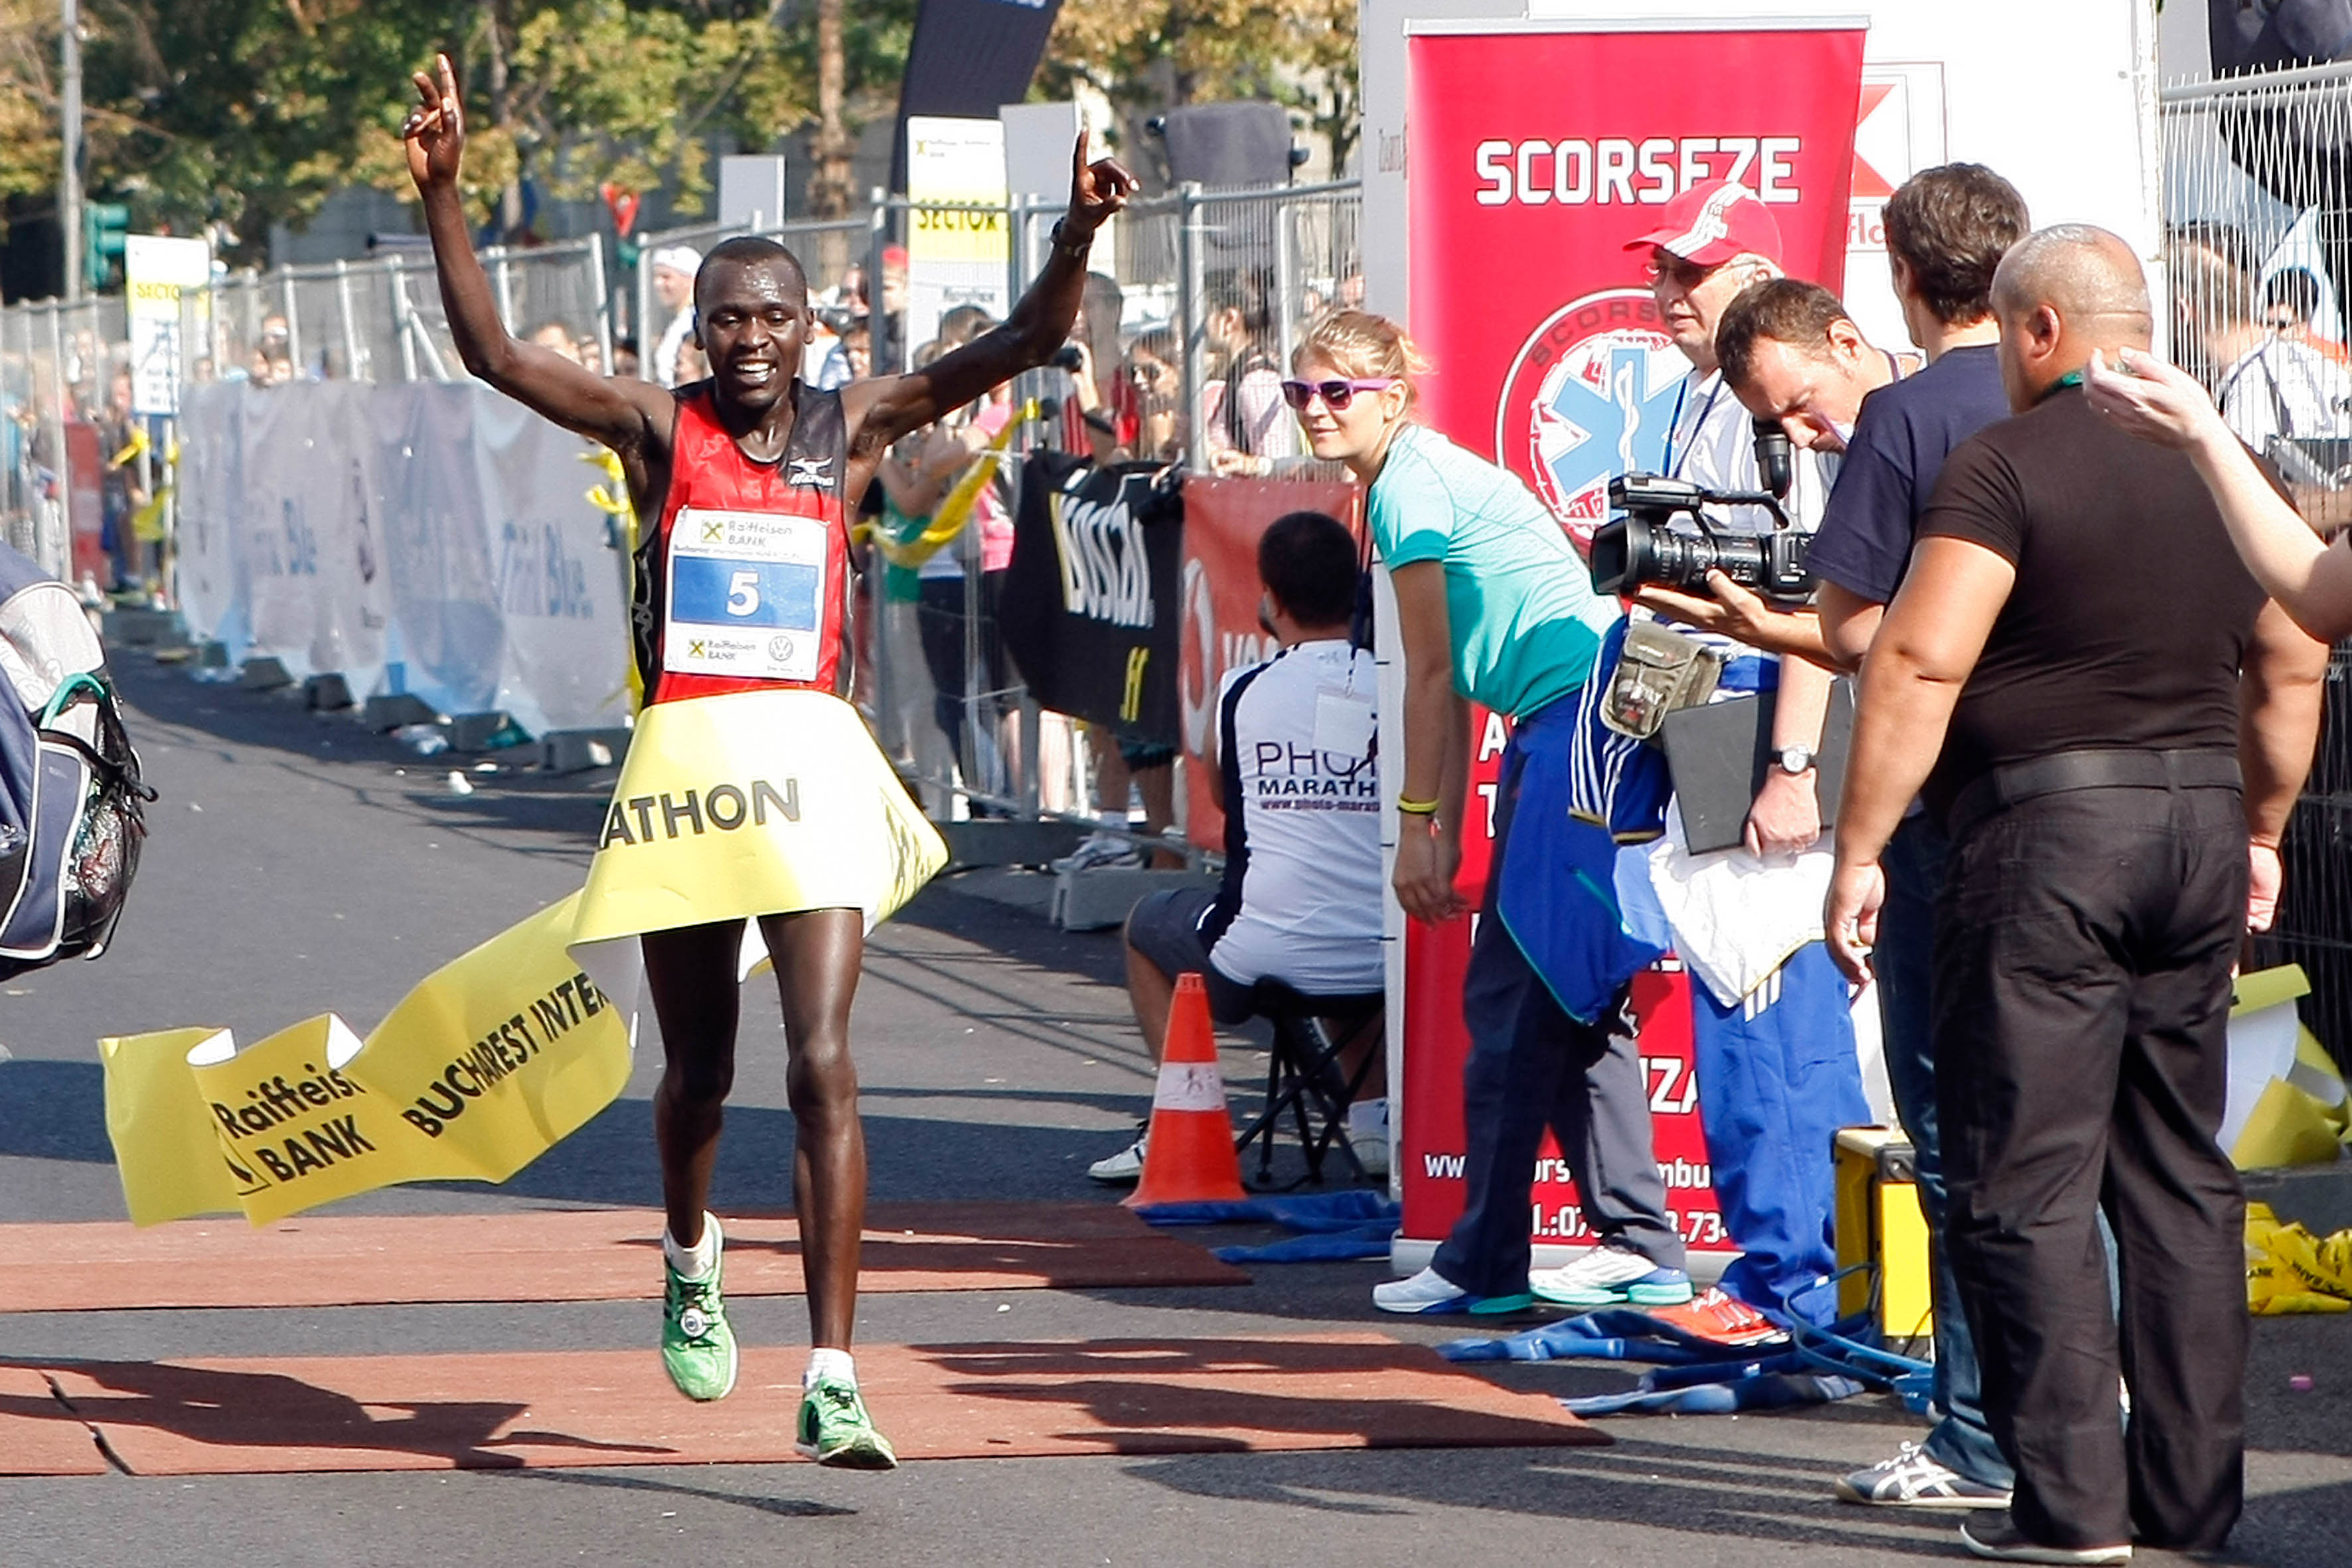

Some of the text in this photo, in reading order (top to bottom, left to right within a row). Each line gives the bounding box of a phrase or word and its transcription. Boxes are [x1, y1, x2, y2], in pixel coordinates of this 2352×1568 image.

[1474, 137, 1801, 205] SCORSEZE
[728, 520, 793, 536] Raiffeisen
[726, 571, 760, 617] 5
[212, 1063, 367, 1139] Raiffeis
[400, 1013, 539, 1138] BUCHAREST
[255, 1115, 376, 1182] BANK
